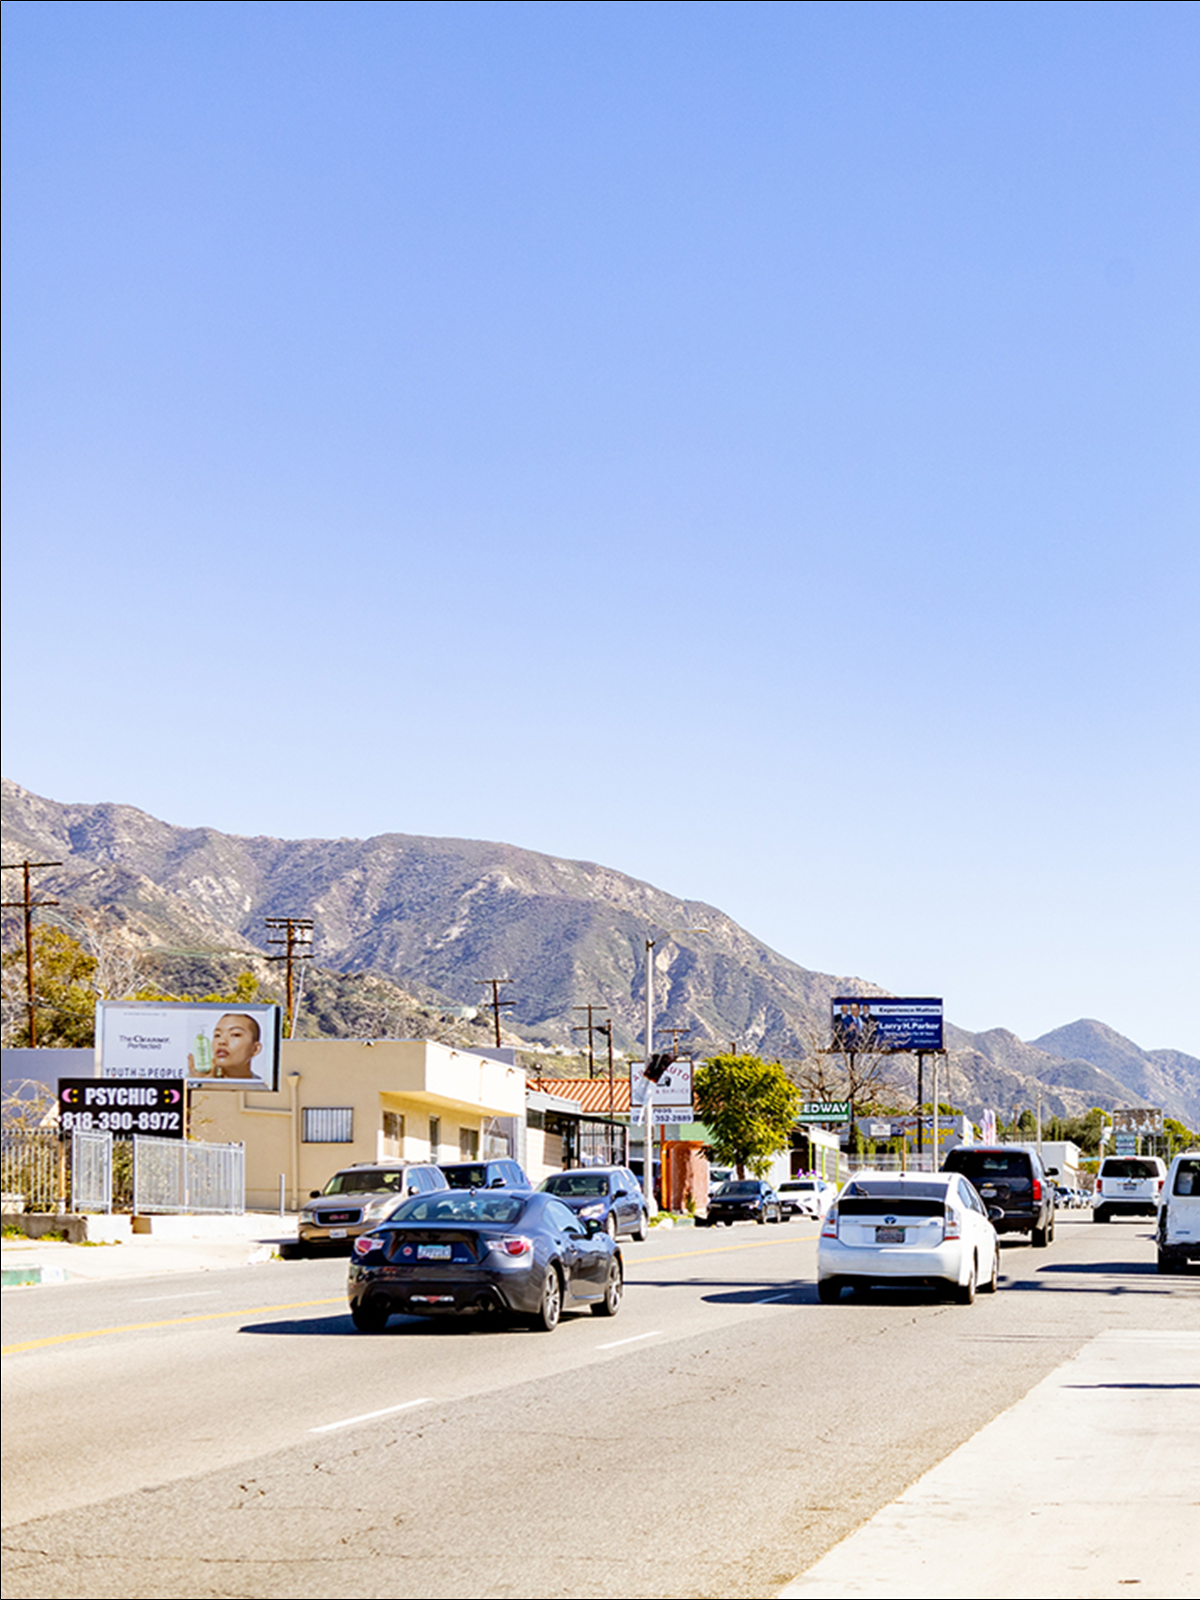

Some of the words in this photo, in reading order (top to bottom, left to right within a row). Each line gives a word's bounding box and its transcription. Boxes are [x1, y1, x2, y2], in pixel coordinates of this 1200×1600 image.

[878, 1022, 901, 1031] Larry
[912, 1022, 940, 1030] Parker
[105, 1066, 137, 1077] YOUTH
[148, 1067, 183, 1078] PEOPLE
[664, 1065, 690, 1082] UTO
[84, 1087, 158, 1106] PSYCHIC
[62, 1111, 180, 1130] 818-390-8972
